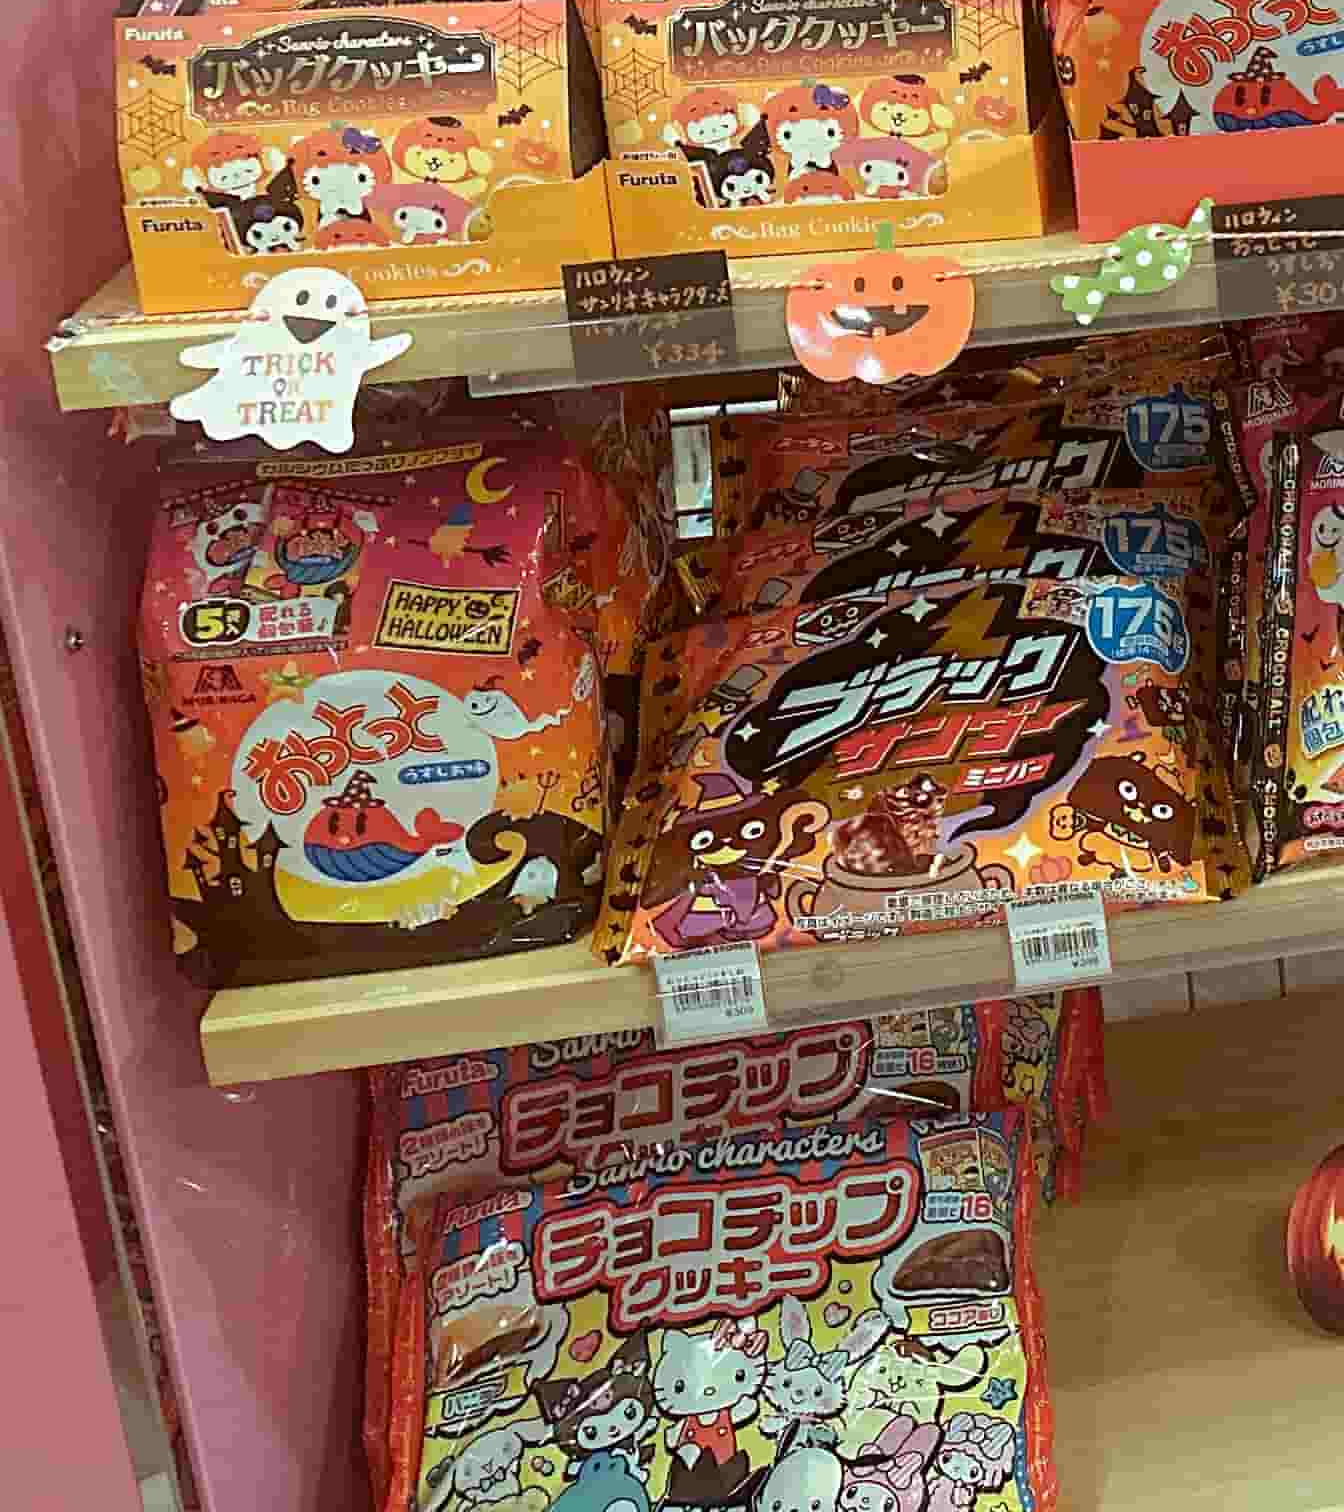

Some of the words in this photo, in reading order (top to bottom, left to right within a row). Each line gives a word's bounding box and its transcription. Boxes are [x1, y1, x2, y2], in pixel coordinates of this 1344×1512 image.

[125, 27, 184, 41] Furuta
[331, 33, 414, 51] characters
[619, 173, 678, 188] Furuta
[143, 218, 203, 232] Furuta
[242, 350, 336, 379] TRICK
[238, 399, 330, 427] TREAT
[394, 592, 462, 615] HAPPY
[1096, 595, 1178, 640] 175
[386, 618, 503, 647] HALLOWEEN
[775, 633, 1068, 768] ブラック
[242, 681, 450, 816] おっとっと
[510, 1030, 865, 1160] チョコチップ
[700, 1122, 884, 1169] characters
[961, 1194, 992, 1219] 16
[544, 1173, 905, 1289] チョコチップ
[624, 1254, 818, 1320] クッキー
